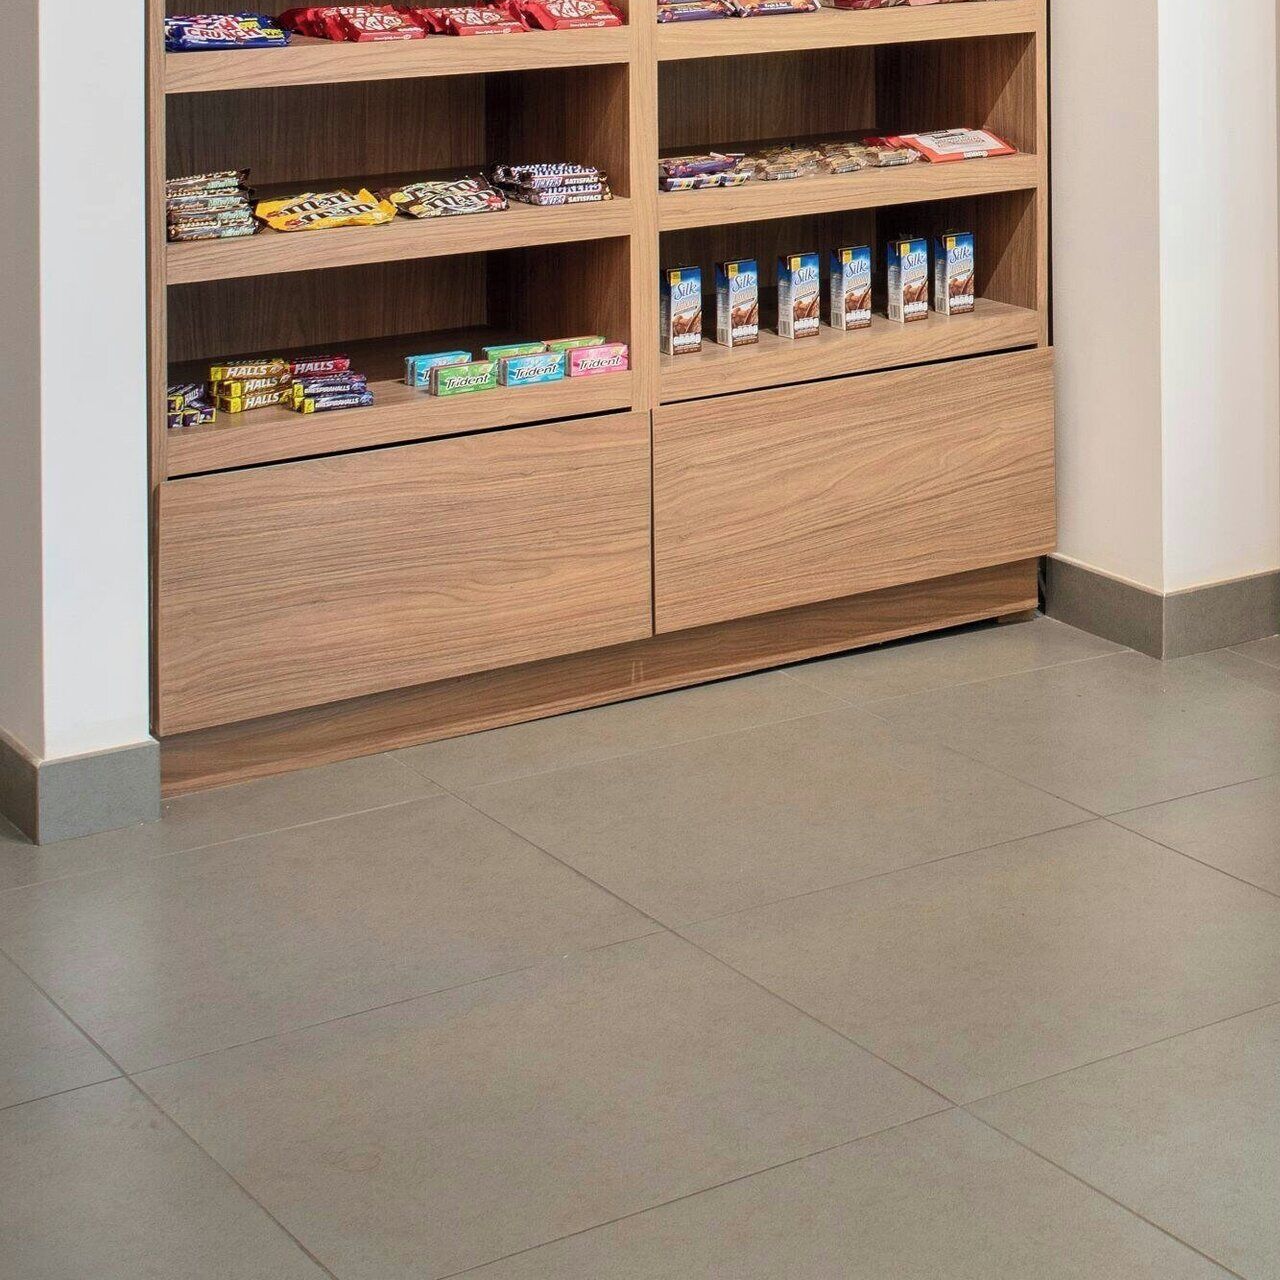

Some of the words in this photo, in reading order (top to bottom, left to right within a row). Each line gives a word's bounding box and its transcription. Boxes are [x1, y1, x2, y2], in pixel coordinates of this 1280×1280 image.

[187, 28, 261, 40] CRUNCH
[904, 252, 927, 270] Silk
[950, 246, 971, 264] Silk
[795, 267, 818, 286] Silk
[846, 261, 868, 278] Silk
[674, 281, 697, 301] Silk
[732, 274, 755, 293] Silk
[226, 365, 268, 378] HALLS
[294, 361, 334, 375] HALLS
[515, 364, 558, 379] Trident
[579, 357, 622, 371] Trident
[244, 377, 277, 392] HALLS
[445, 373, 490, 390] Trident
[244, 393, 280, 409] HALLS
